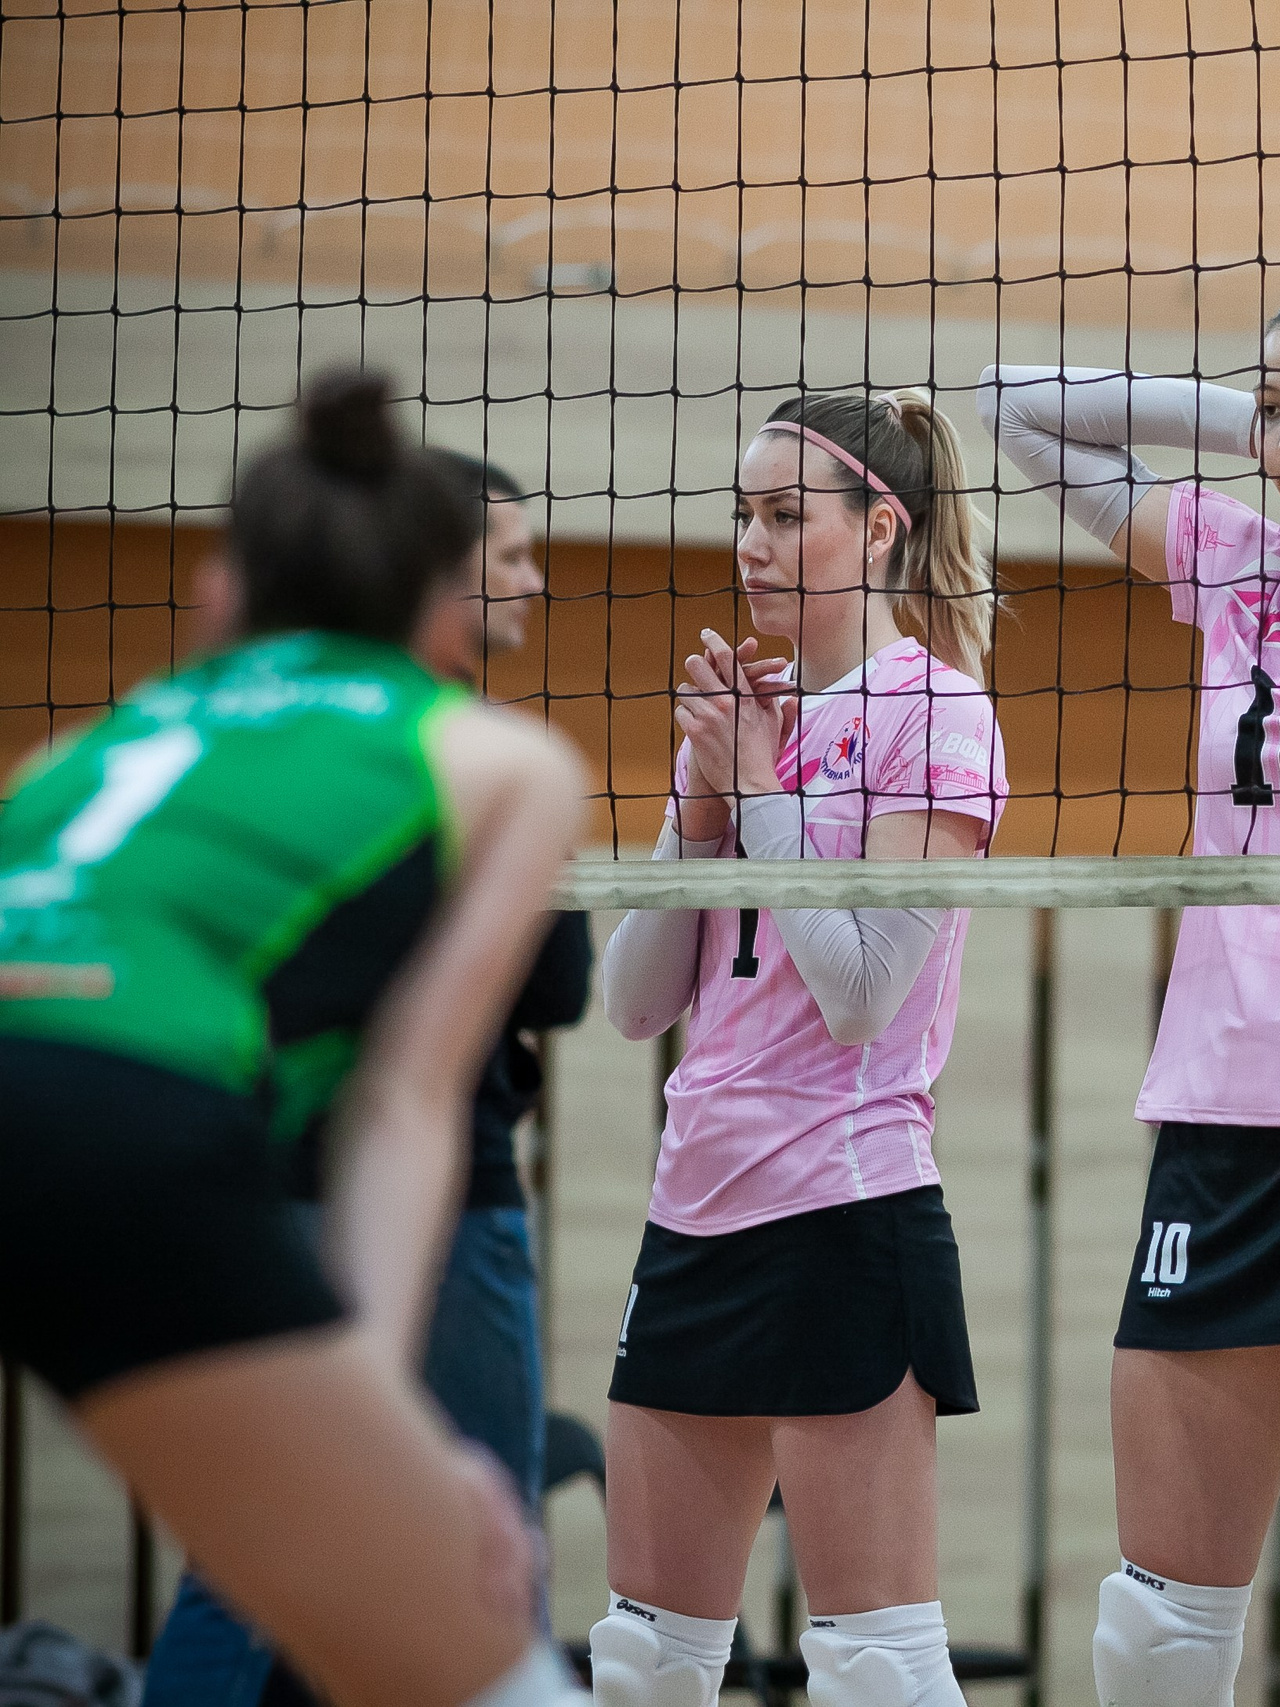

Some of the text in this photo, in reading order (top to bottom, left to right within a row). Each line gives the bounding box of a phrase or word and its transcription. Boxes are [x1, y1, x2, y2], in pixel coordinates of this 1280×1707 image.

[58, 727, 202, 864] 1
[1141, 1222, 1191, 1284] 10
[1147, 1287, 1172, 1298] Hitch
